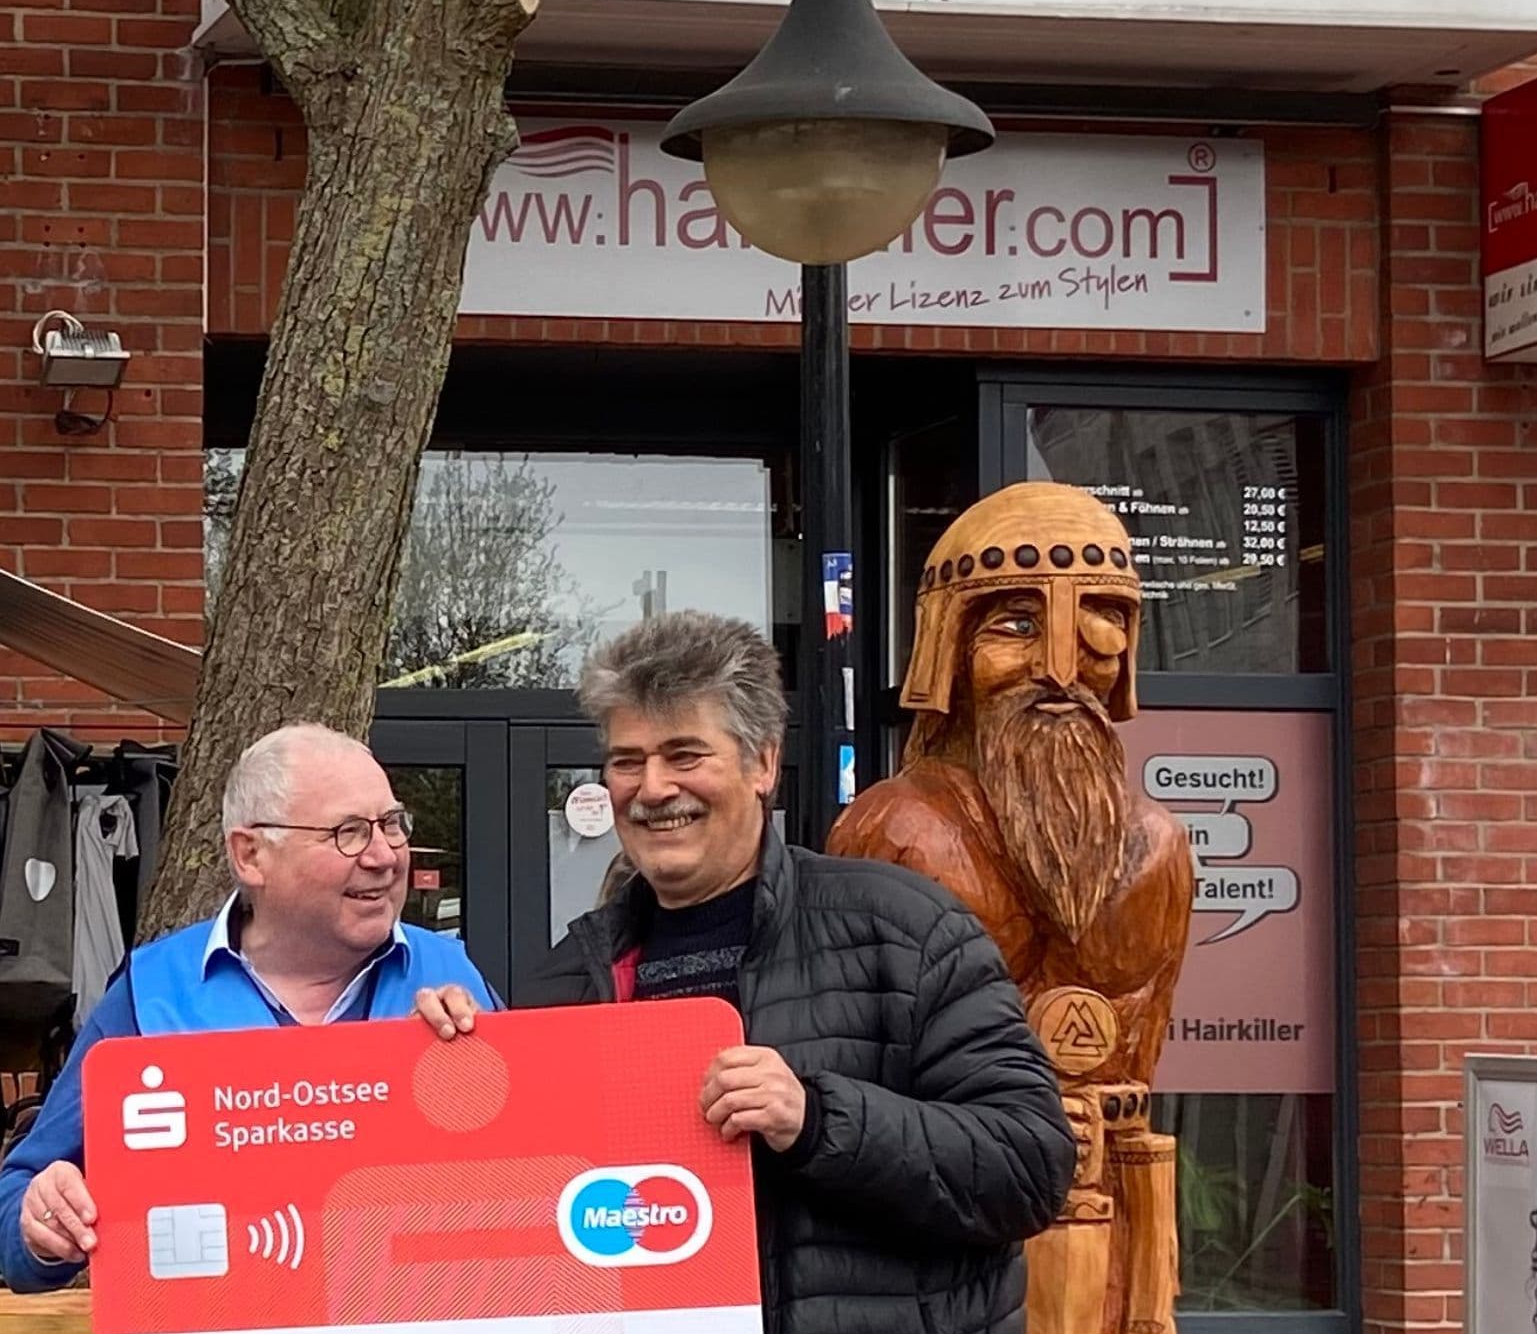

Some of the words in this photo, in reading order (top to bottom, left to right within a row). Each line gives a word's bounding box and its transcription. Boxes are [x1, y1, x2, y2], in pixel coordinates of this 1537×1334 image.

[848, 291, 882, 313] er
[890, 281, 991, 311] Lizenz
[999, 279, 1052, 301] zum
[1058, 265, 1149, 311] Stylen
[1159, 535, 1214, 548] Strähnen
[1155, 767, 1265, 790] Gesucht!
[1188, 824, 1209, 846] in
[1193, 878, 1275, 900] Talent!
[1182, 1019, 1305, 1042] Hairkiller
[214, 1079, 390, 1111] Nord-Ostsee
[214, 1117, 356, 1152] Sparkasse
[1483, 1138, 1530, 1157] WELLA
[582, 1202, 689, 1229] Maestro
